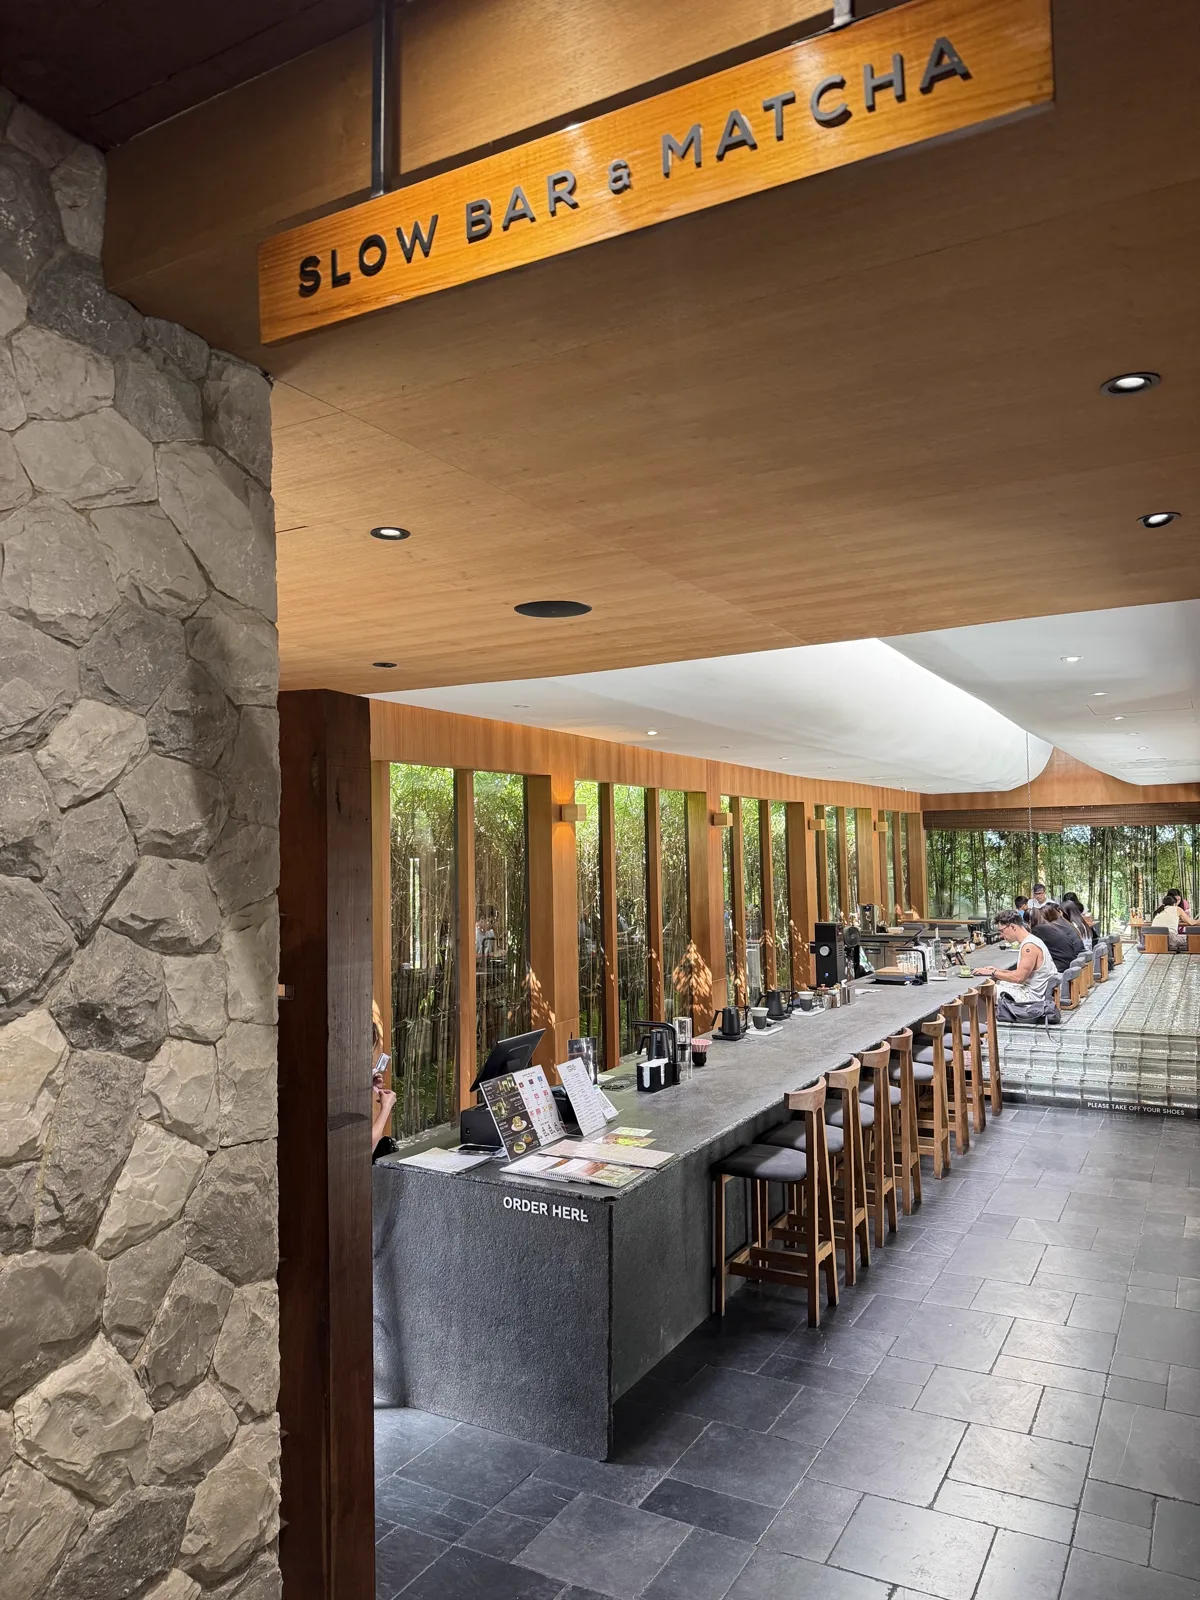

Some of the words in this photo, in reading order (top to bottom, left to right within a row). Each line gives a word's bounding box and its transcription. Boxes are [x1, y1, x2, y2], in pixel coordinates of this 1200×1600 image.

[299, 214, 439, 297] SLOW
[465, 170, 580, 244] BAR
[608, 159, 632, 195] &
[661, 36, 973, 178] MATCHA
[1087, 1101, 1110, 1109] PLEASE
[1111, 1103, 1128, 1111] TAKE
[1162, 1108, 1185, 1116] SHOES
[503, 1196, 549, 1216] ORDER
[552, 1204, 589, 1223] HERE
